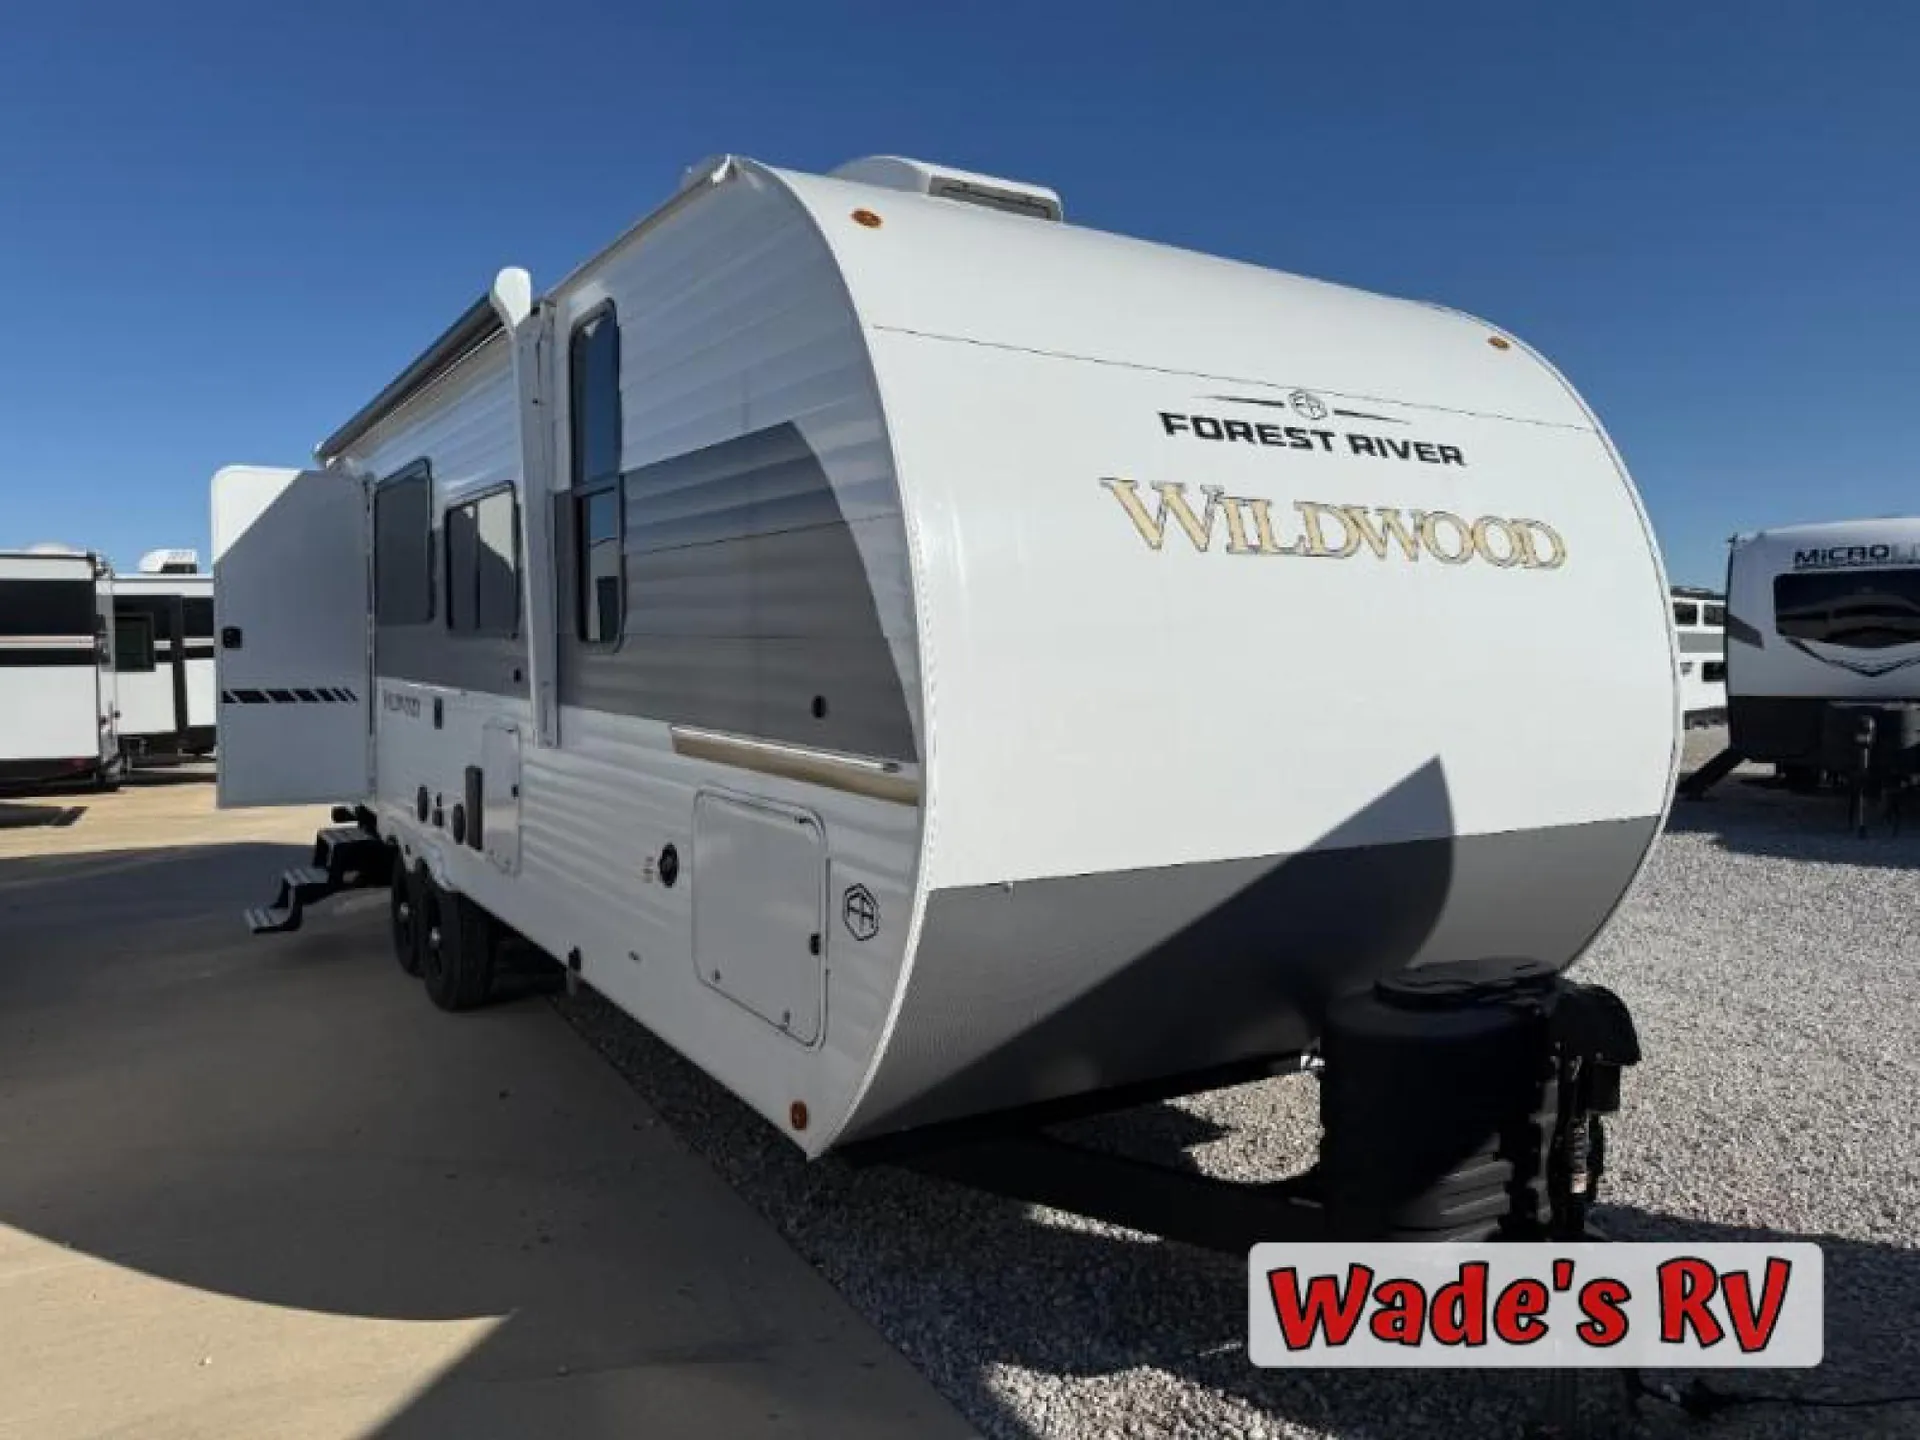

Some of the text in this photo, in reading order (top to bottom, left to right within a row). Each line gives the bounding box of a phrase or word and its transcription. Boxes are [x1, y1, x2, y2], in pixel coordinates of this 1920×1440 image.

[1157, 411, 1467, 467] FOREST RIVER
[1099, 476, 1567, 571] WILDWOOD
